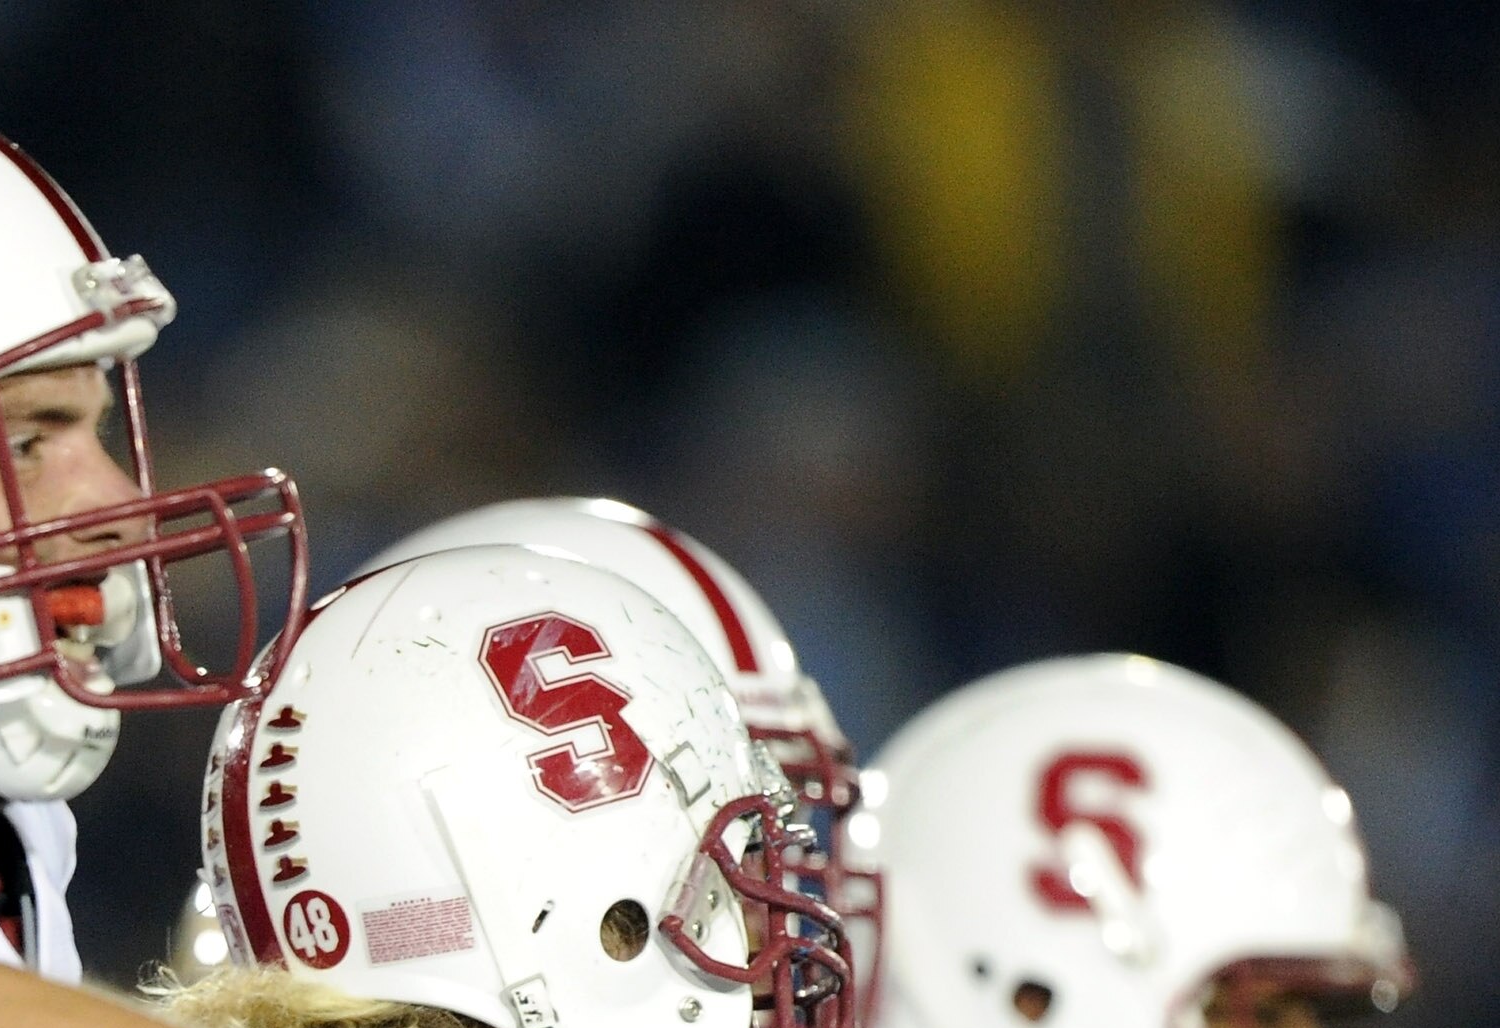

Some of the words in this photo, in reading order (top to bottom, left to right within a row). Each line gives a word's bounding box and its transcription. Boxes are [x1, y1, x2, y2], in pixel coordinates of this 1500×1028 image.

[479, 611, 654, 812] S
[1025, 748, 1153, 914] S
[289, 897, 339, 958] 48
